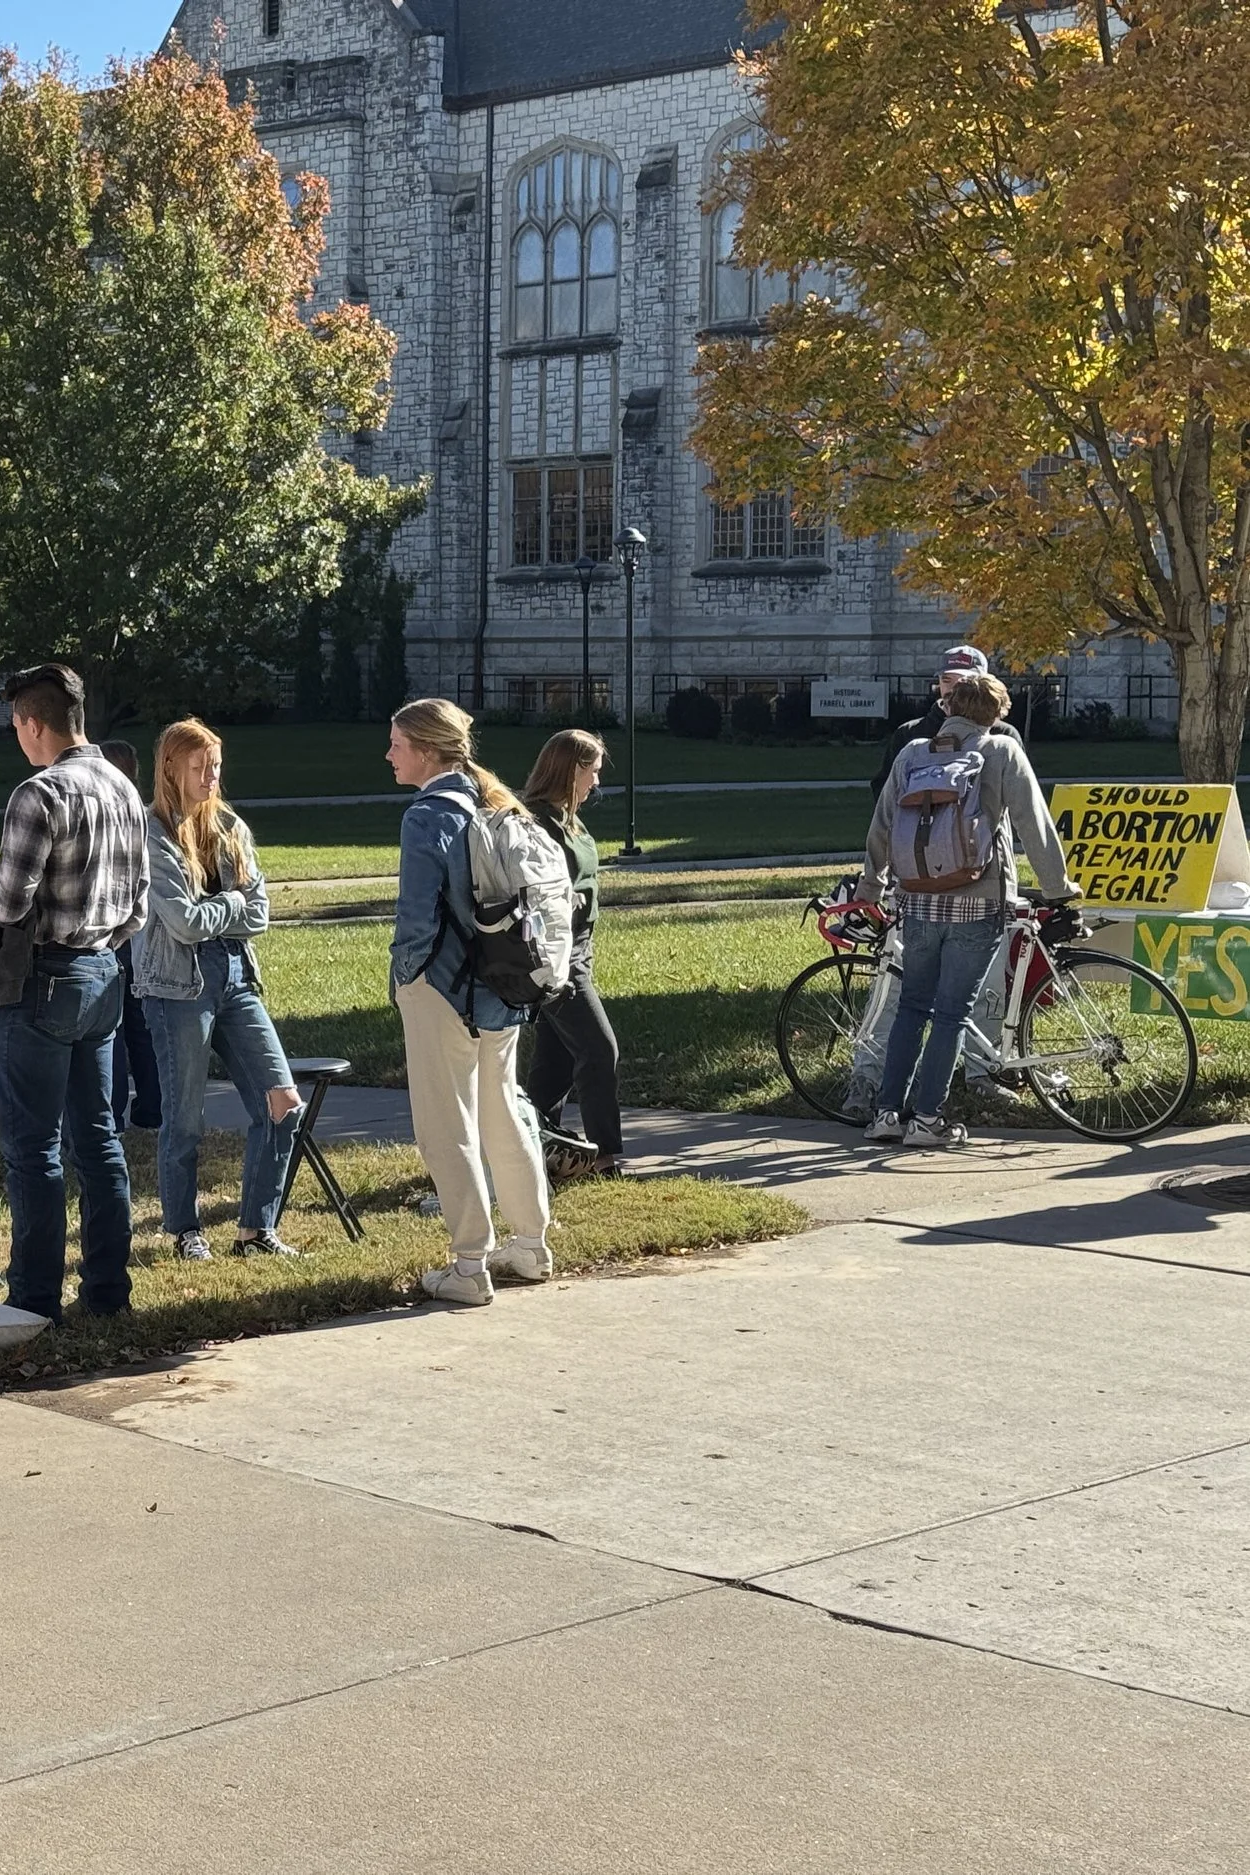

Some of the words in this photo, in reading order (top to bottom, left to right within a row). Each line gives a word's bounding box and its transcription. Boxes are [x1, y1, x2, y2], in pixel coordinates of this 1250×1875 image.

[1086, 787, 1190, 806] SHOULD
[1055, 810, 1223, 844] ABORTION
[1066, 843, 1187, 871] REMAIN
[1137, 922, 1250, 1016] YES
